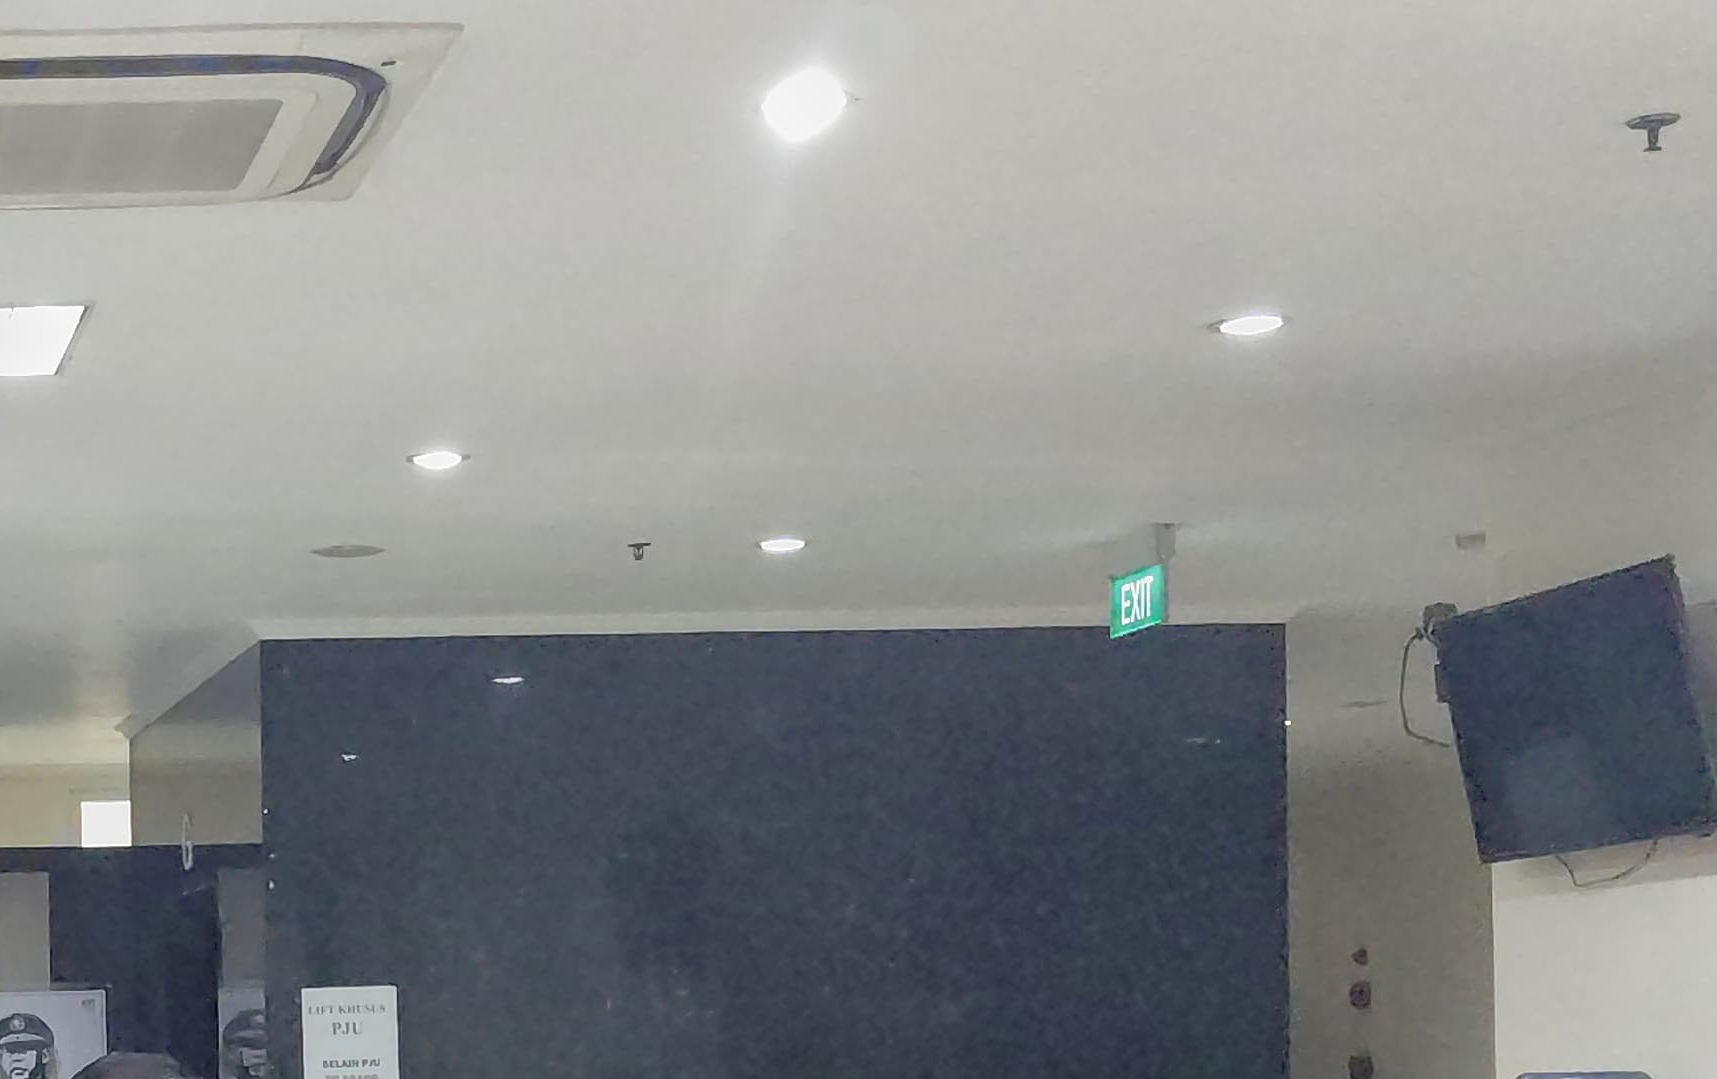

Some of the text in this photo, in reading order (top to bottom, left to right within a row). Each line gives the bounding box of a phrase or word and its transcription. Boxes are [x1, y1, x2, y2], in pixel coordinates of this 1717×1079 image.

[1121, 575, 1154, 625] EXIT
[308, 1005, 334, 1015] LIFT
[331, 1022, 363, 1035] PJU
